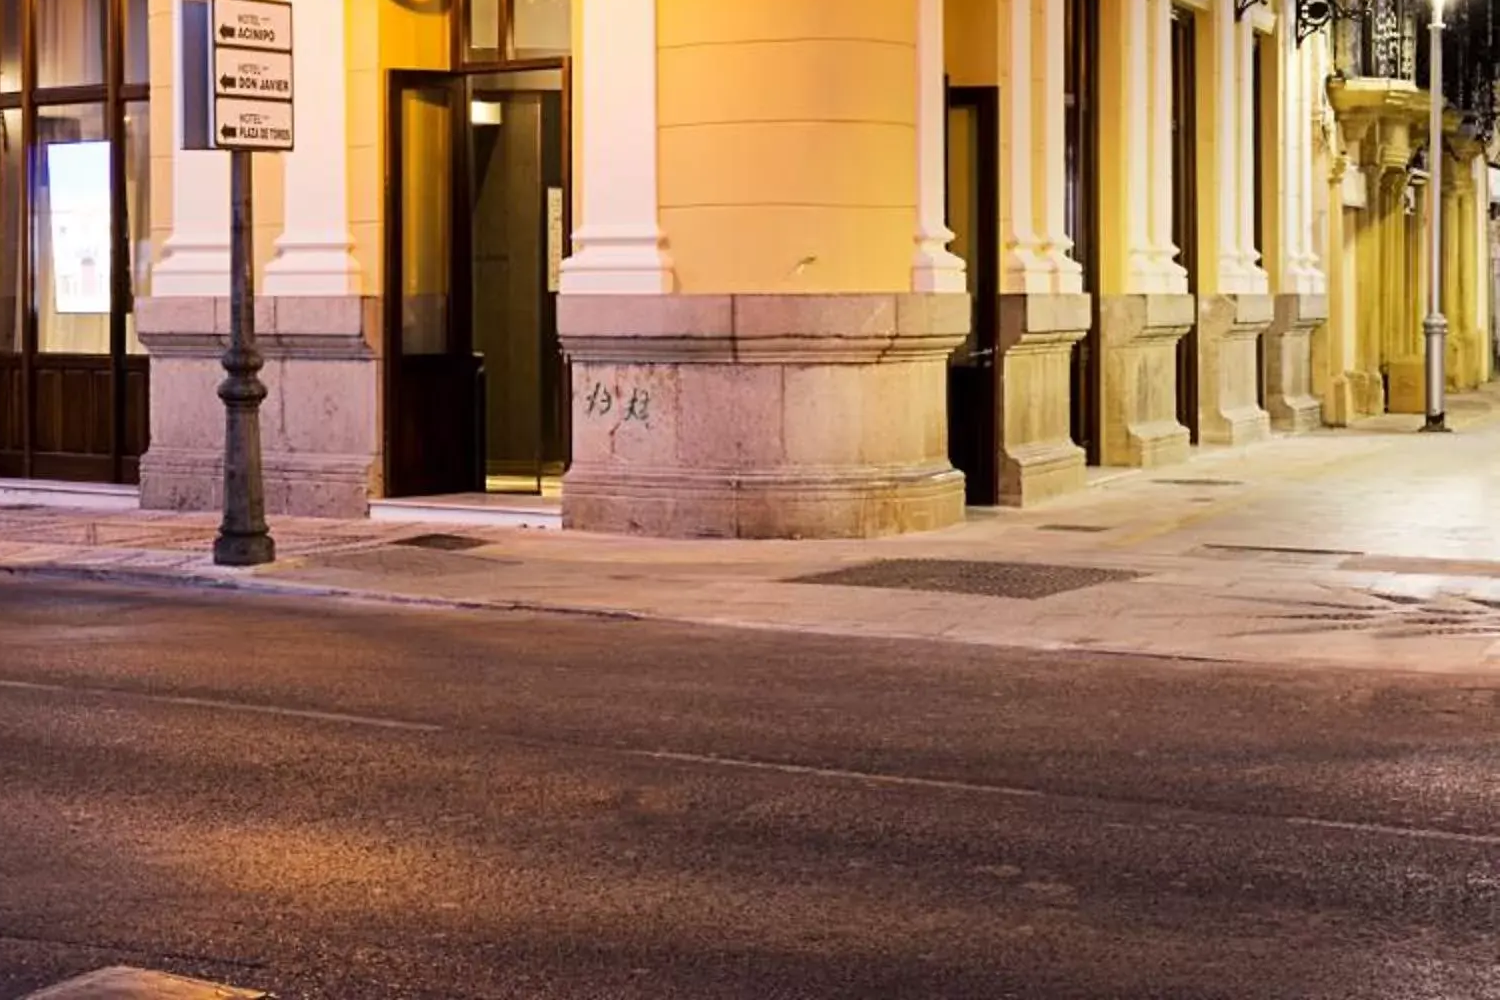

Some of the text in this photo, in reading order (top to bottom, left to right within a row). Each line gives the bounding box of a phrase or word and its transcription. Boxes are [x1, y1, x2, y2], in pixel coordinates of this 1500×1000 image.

[238, 14, 261, 26] HOTEL
[237, 27, 276, 42] ACINIPO
[238, 63, 261, 75] HOTEL
[238, 76, 289, 92] DON JAVIER
[241, 113, 263, 124] HOTEL
[240, 126, 259, 138] PLAZA
[260, 128, 269, 139] DE
